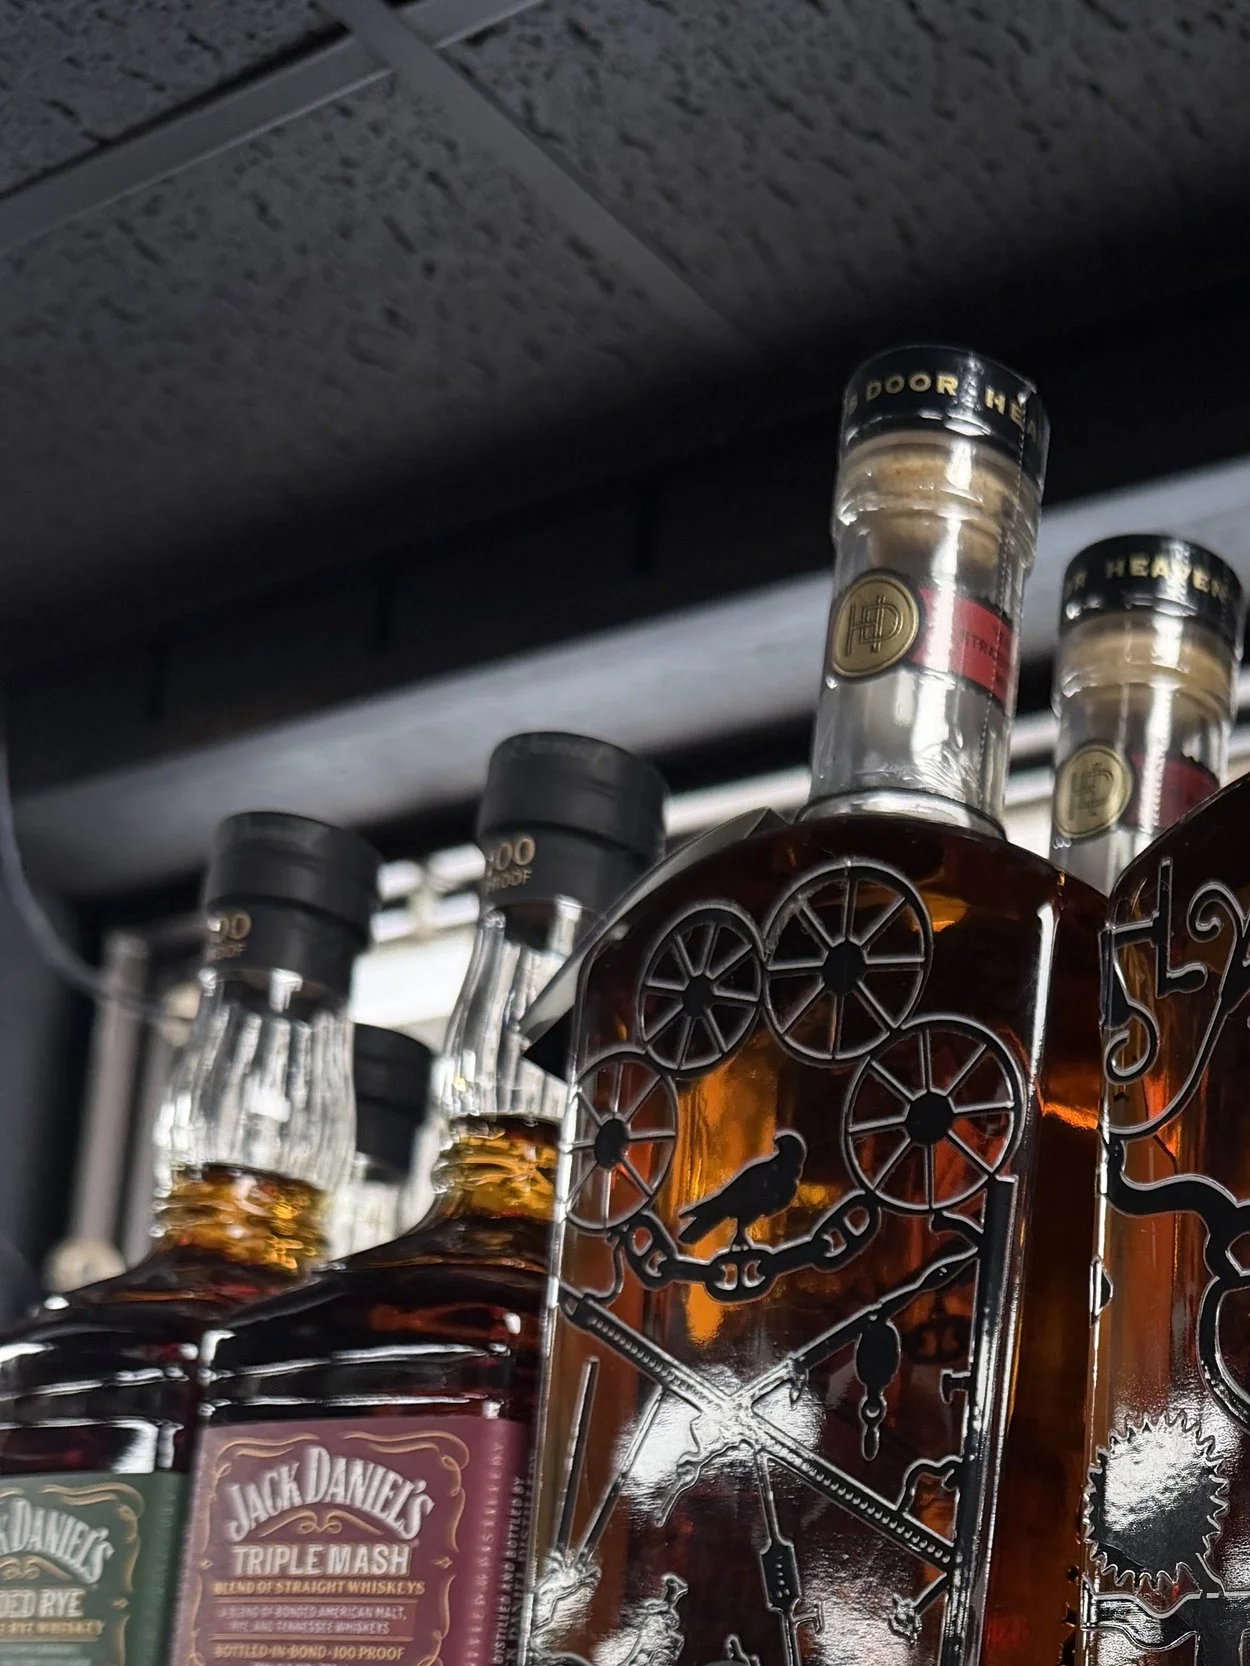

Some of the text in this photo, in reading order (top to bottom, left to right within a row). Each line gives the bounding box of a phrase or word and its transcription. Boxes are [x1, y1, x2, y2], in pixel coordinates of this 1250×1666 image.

[866, 372, 959, 402] DOOR
[226, 1461, 302, 1542] JACK
[300, 1444, 436, 1541] DANIEL'S
[232, 1543, 412, 1578] TRIPLE MASH
[38, 1587, 86, 1618] RYE
[274, 1580, 345, 1596] STRAIGHT
[347, 1580, 426, 1596] WHISKEYS
